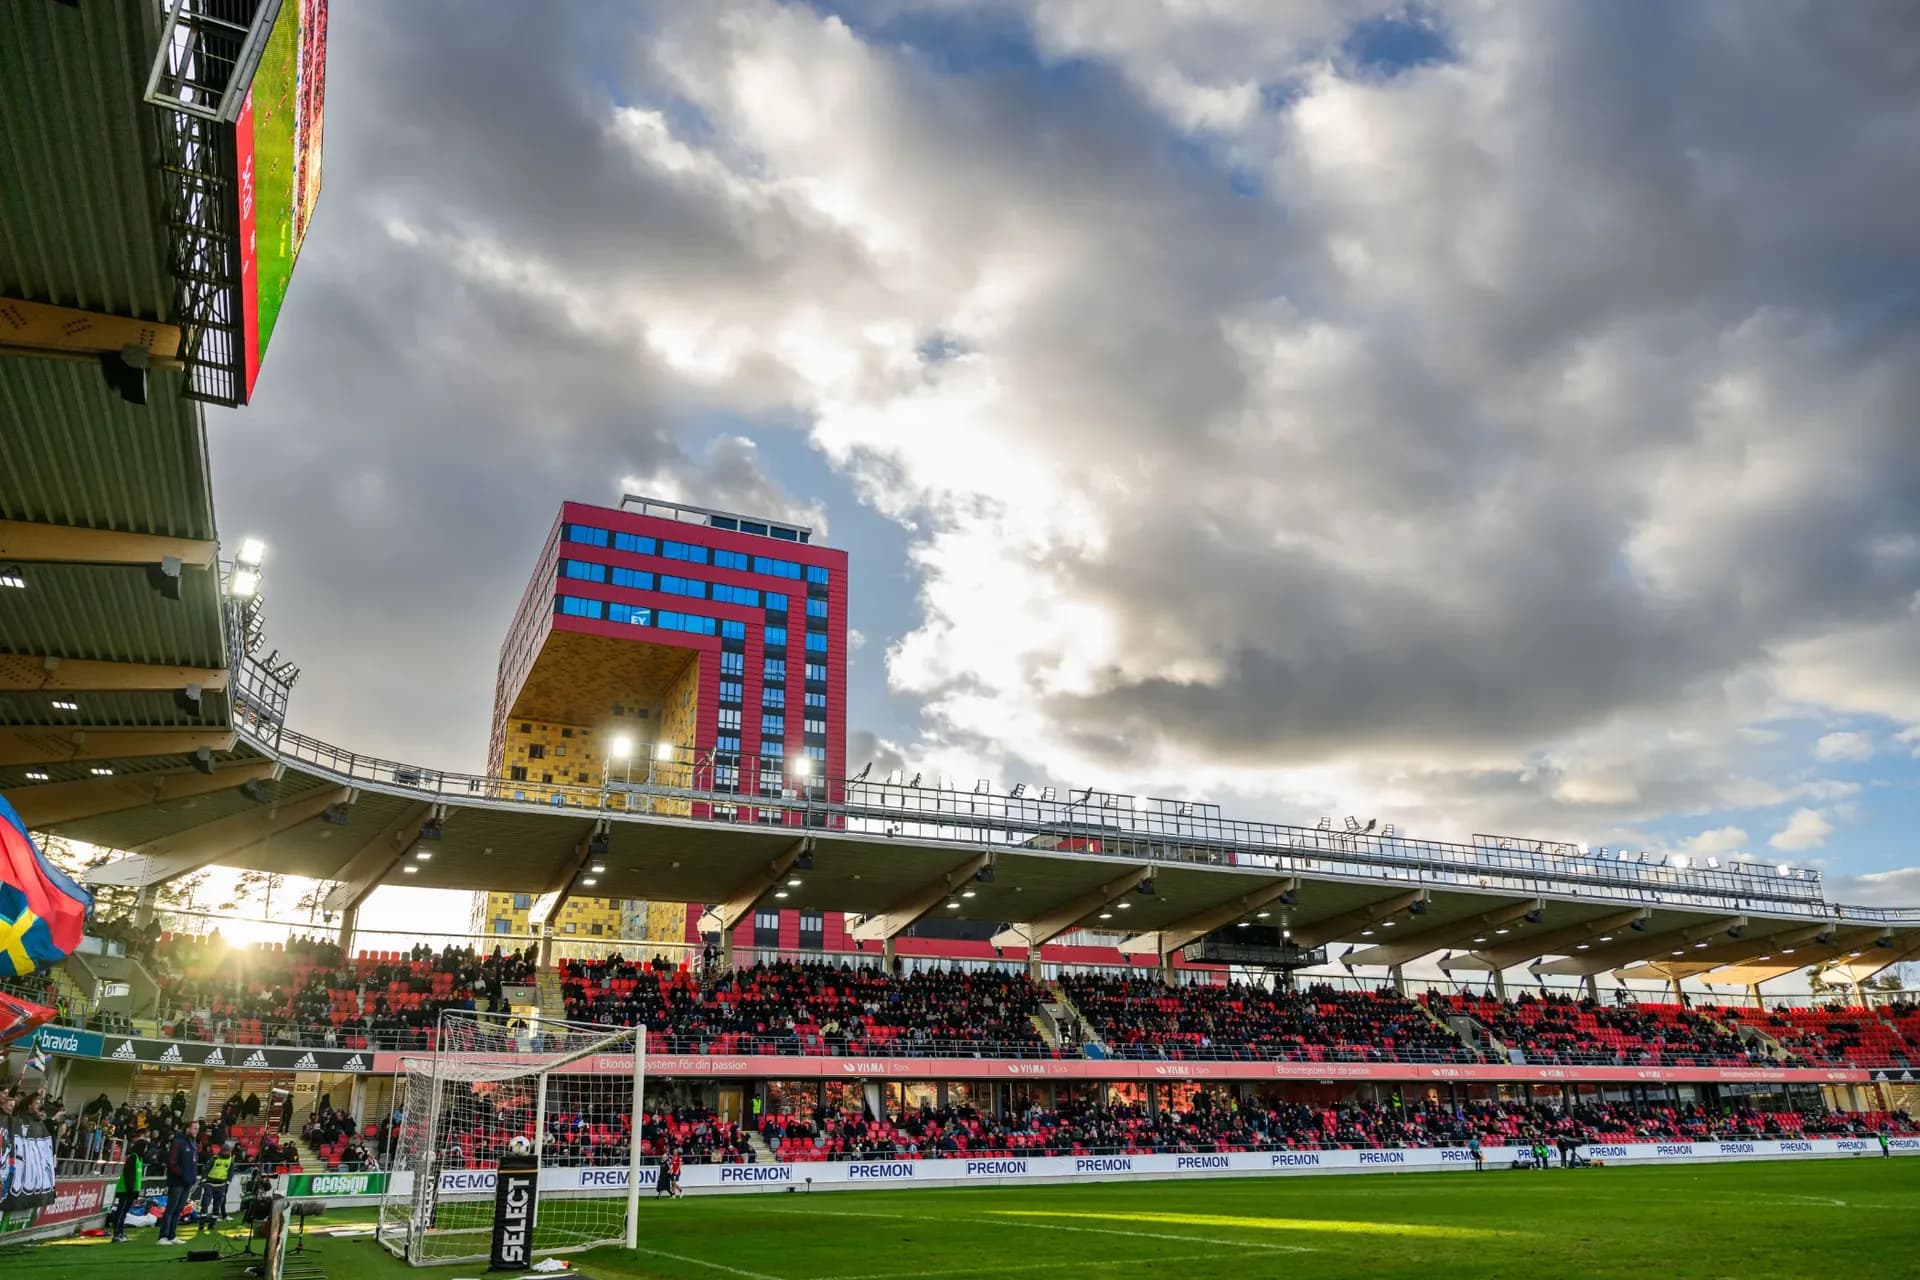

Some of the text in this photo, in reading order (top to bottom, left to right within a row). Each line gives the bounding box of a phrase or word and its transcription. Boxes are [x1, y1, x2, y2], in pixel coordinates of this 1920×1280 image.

[631, 615, 647, 626] EY
[41, 1031, 79, 1052] bravida
[679, 1059, 693, 1070] för
[695, 1060, 711, 1070] din
[712, 1061, 748, 1073] passion
[857, 1063, 885, 1073] VISMA
[1020, 1064, 1045, 1073] VISMA
[1167, 1066, 1190, 1075] VISMA
[1656, 1145, 1693, 1155] PREMON
[1720, 1143, 1754, 1153] PREMON
[1780, 1142, 1812, 1152] PREMON
[1837, 1140, 1867, 1150] PREMON
[1359, 1152, 1404, 1163] PREMON
[1589, 1146, 1627, 1157] PREMON
[1076, 1158, 1131, 1172] PREMON
[1177, 1156, 1229, 1169] PREMON
[1272, 1153, 1320, 1166] PREMON
[849, 1164, 913, 1178] PREMON
[967, 1161, 1026, 1175] PREMON
[721, 1167, 790, 1182] PREMON
[312, 1176, 369, 1195] ecosign
[501, 1177, 530, 1263] SELECT
